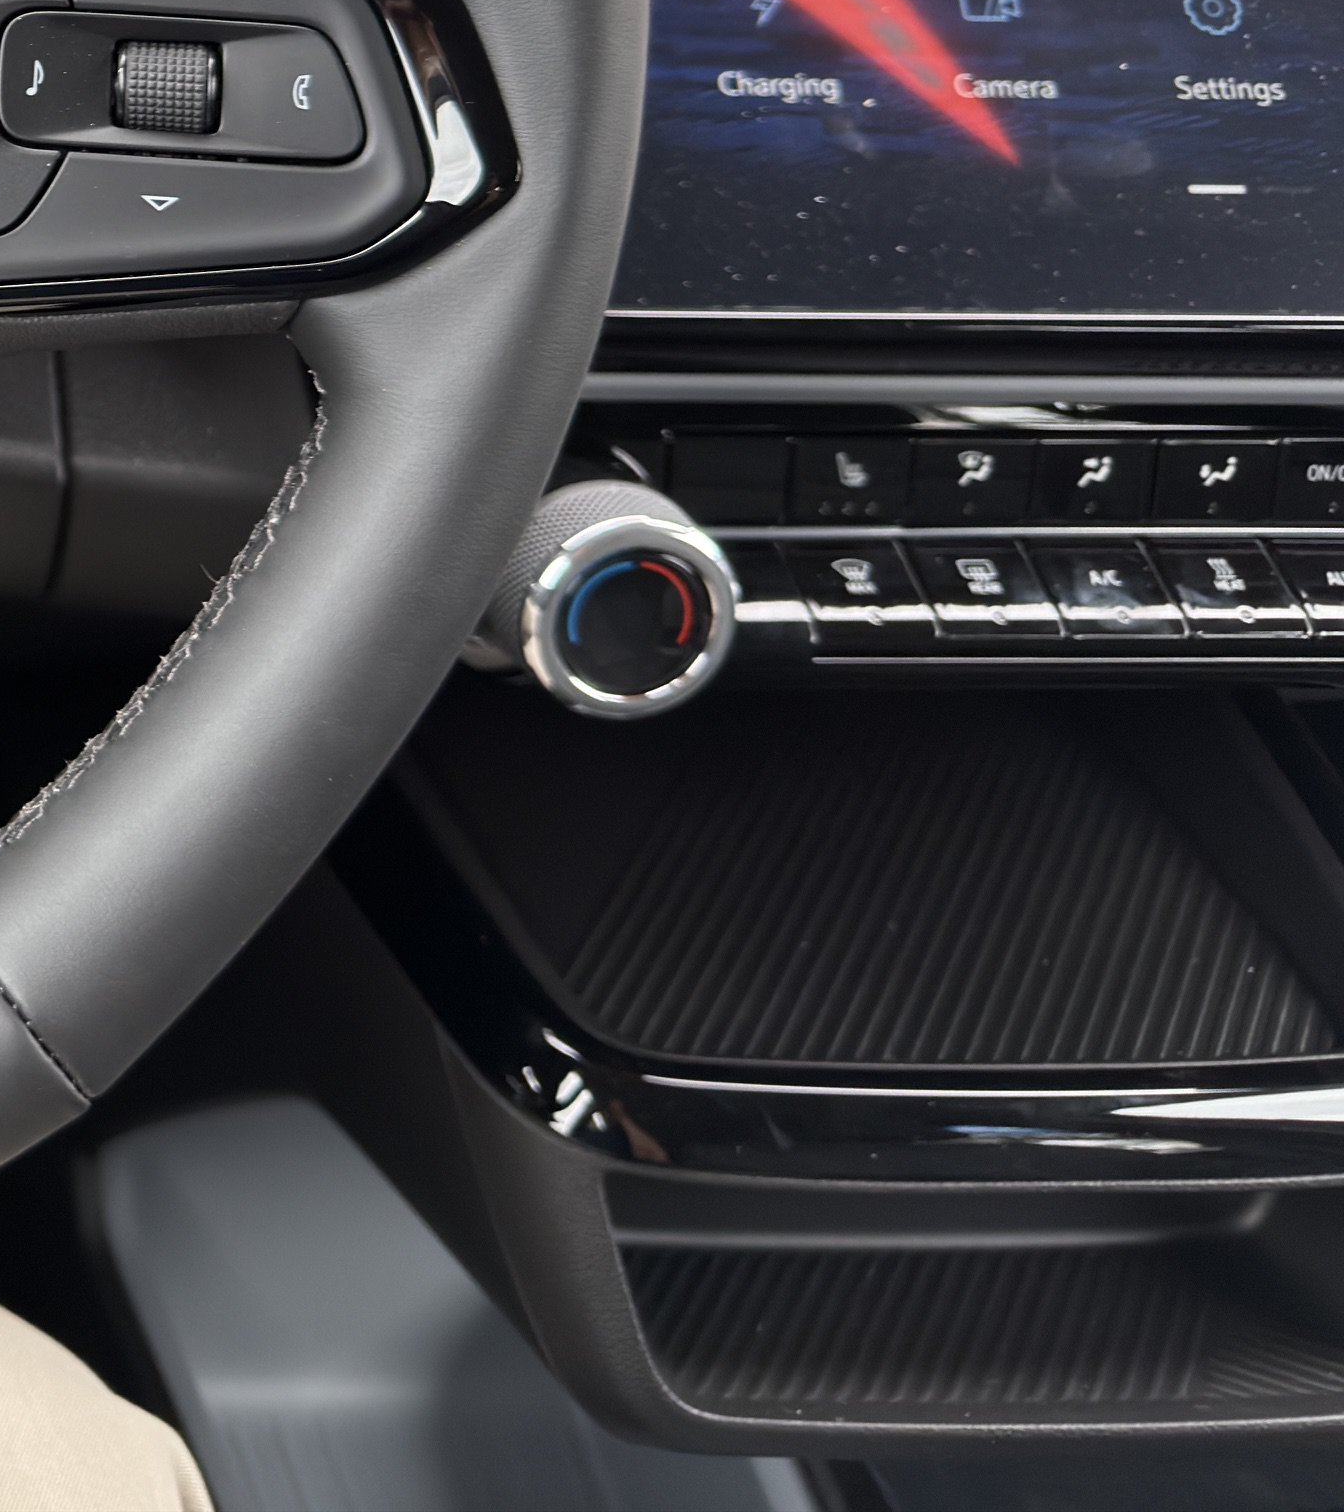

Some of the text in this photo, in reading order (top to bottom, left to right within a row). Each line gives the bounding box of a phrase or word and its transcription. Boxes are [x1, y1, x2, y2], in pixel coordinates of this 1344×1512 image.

[717, 71, 842, 104] Charging
[953, 73, 1059, 99] Camera
[1174, 75, 1287, 106] Settings
[1089, 569, 1123, 587] A/C
